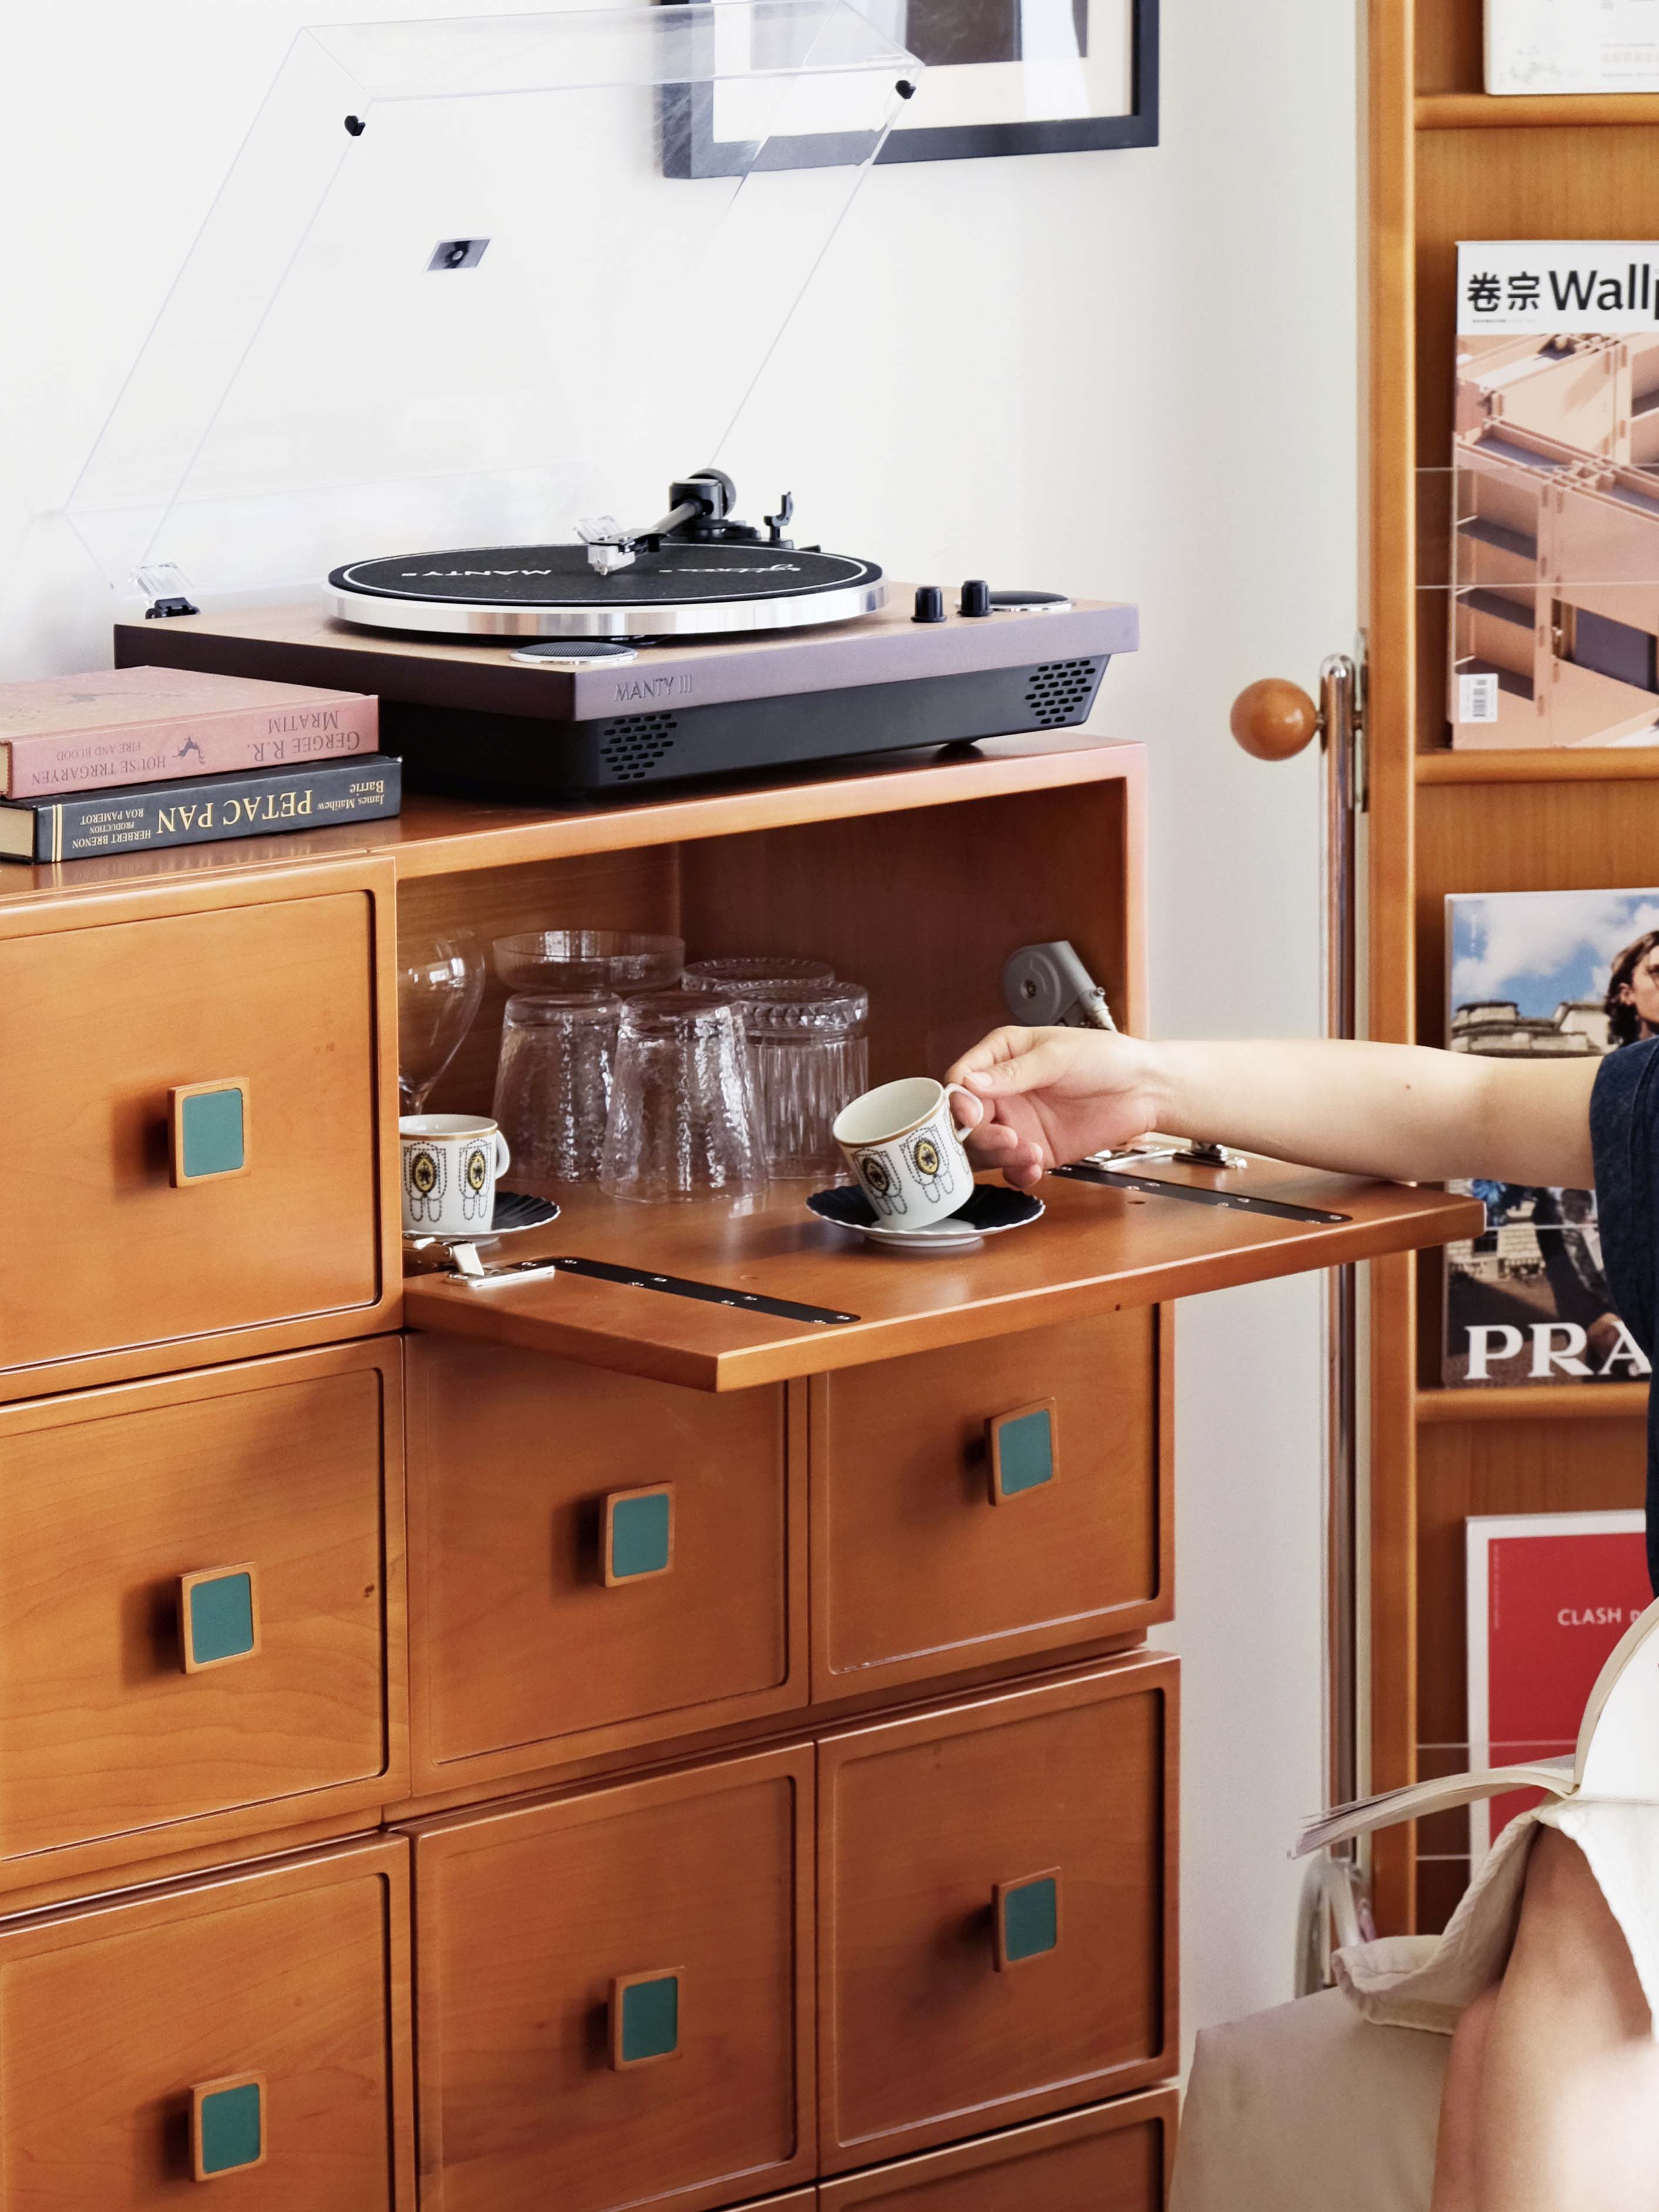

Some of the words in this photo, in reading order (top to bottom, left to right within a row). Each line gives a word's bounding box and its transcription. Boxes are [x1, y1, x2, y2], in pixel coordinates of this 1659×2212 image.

[1467, 271, 1540, 312] 卷宗
[615, 676, 674, 702] MANTY
[268, 711, 339, 733] MRATIM
[95, 745, 116, 756] AND
[121, 742, 141, 752] FIRE
[292, 731, 360, 753] GERGEE
[56, 748, 91, 761] BLOOD
[247, 740, 284, 762] R.R.
[121, 756, 166, 773] HOUSE
[32, 763, 116, 785] TRRGARYEN
[349, 780, 384, 796] Barrie
[223, 790, 312, 826] PETAC
[358, 794, 385, 806] James
[80, 810, 123, 826] PAMEROT
[125, 808, 144, 819] ROA
[156, 803, 214, 834] PAN
[89, 821, 135, 834] PRODUCTION
[72, 835, 108, 849] BRENON
[110, 830, 151, 844] HERBERT
[1463, 1320, 1653, 1380] PRA
[1557, 1607, 1622, 1626] CLASH
